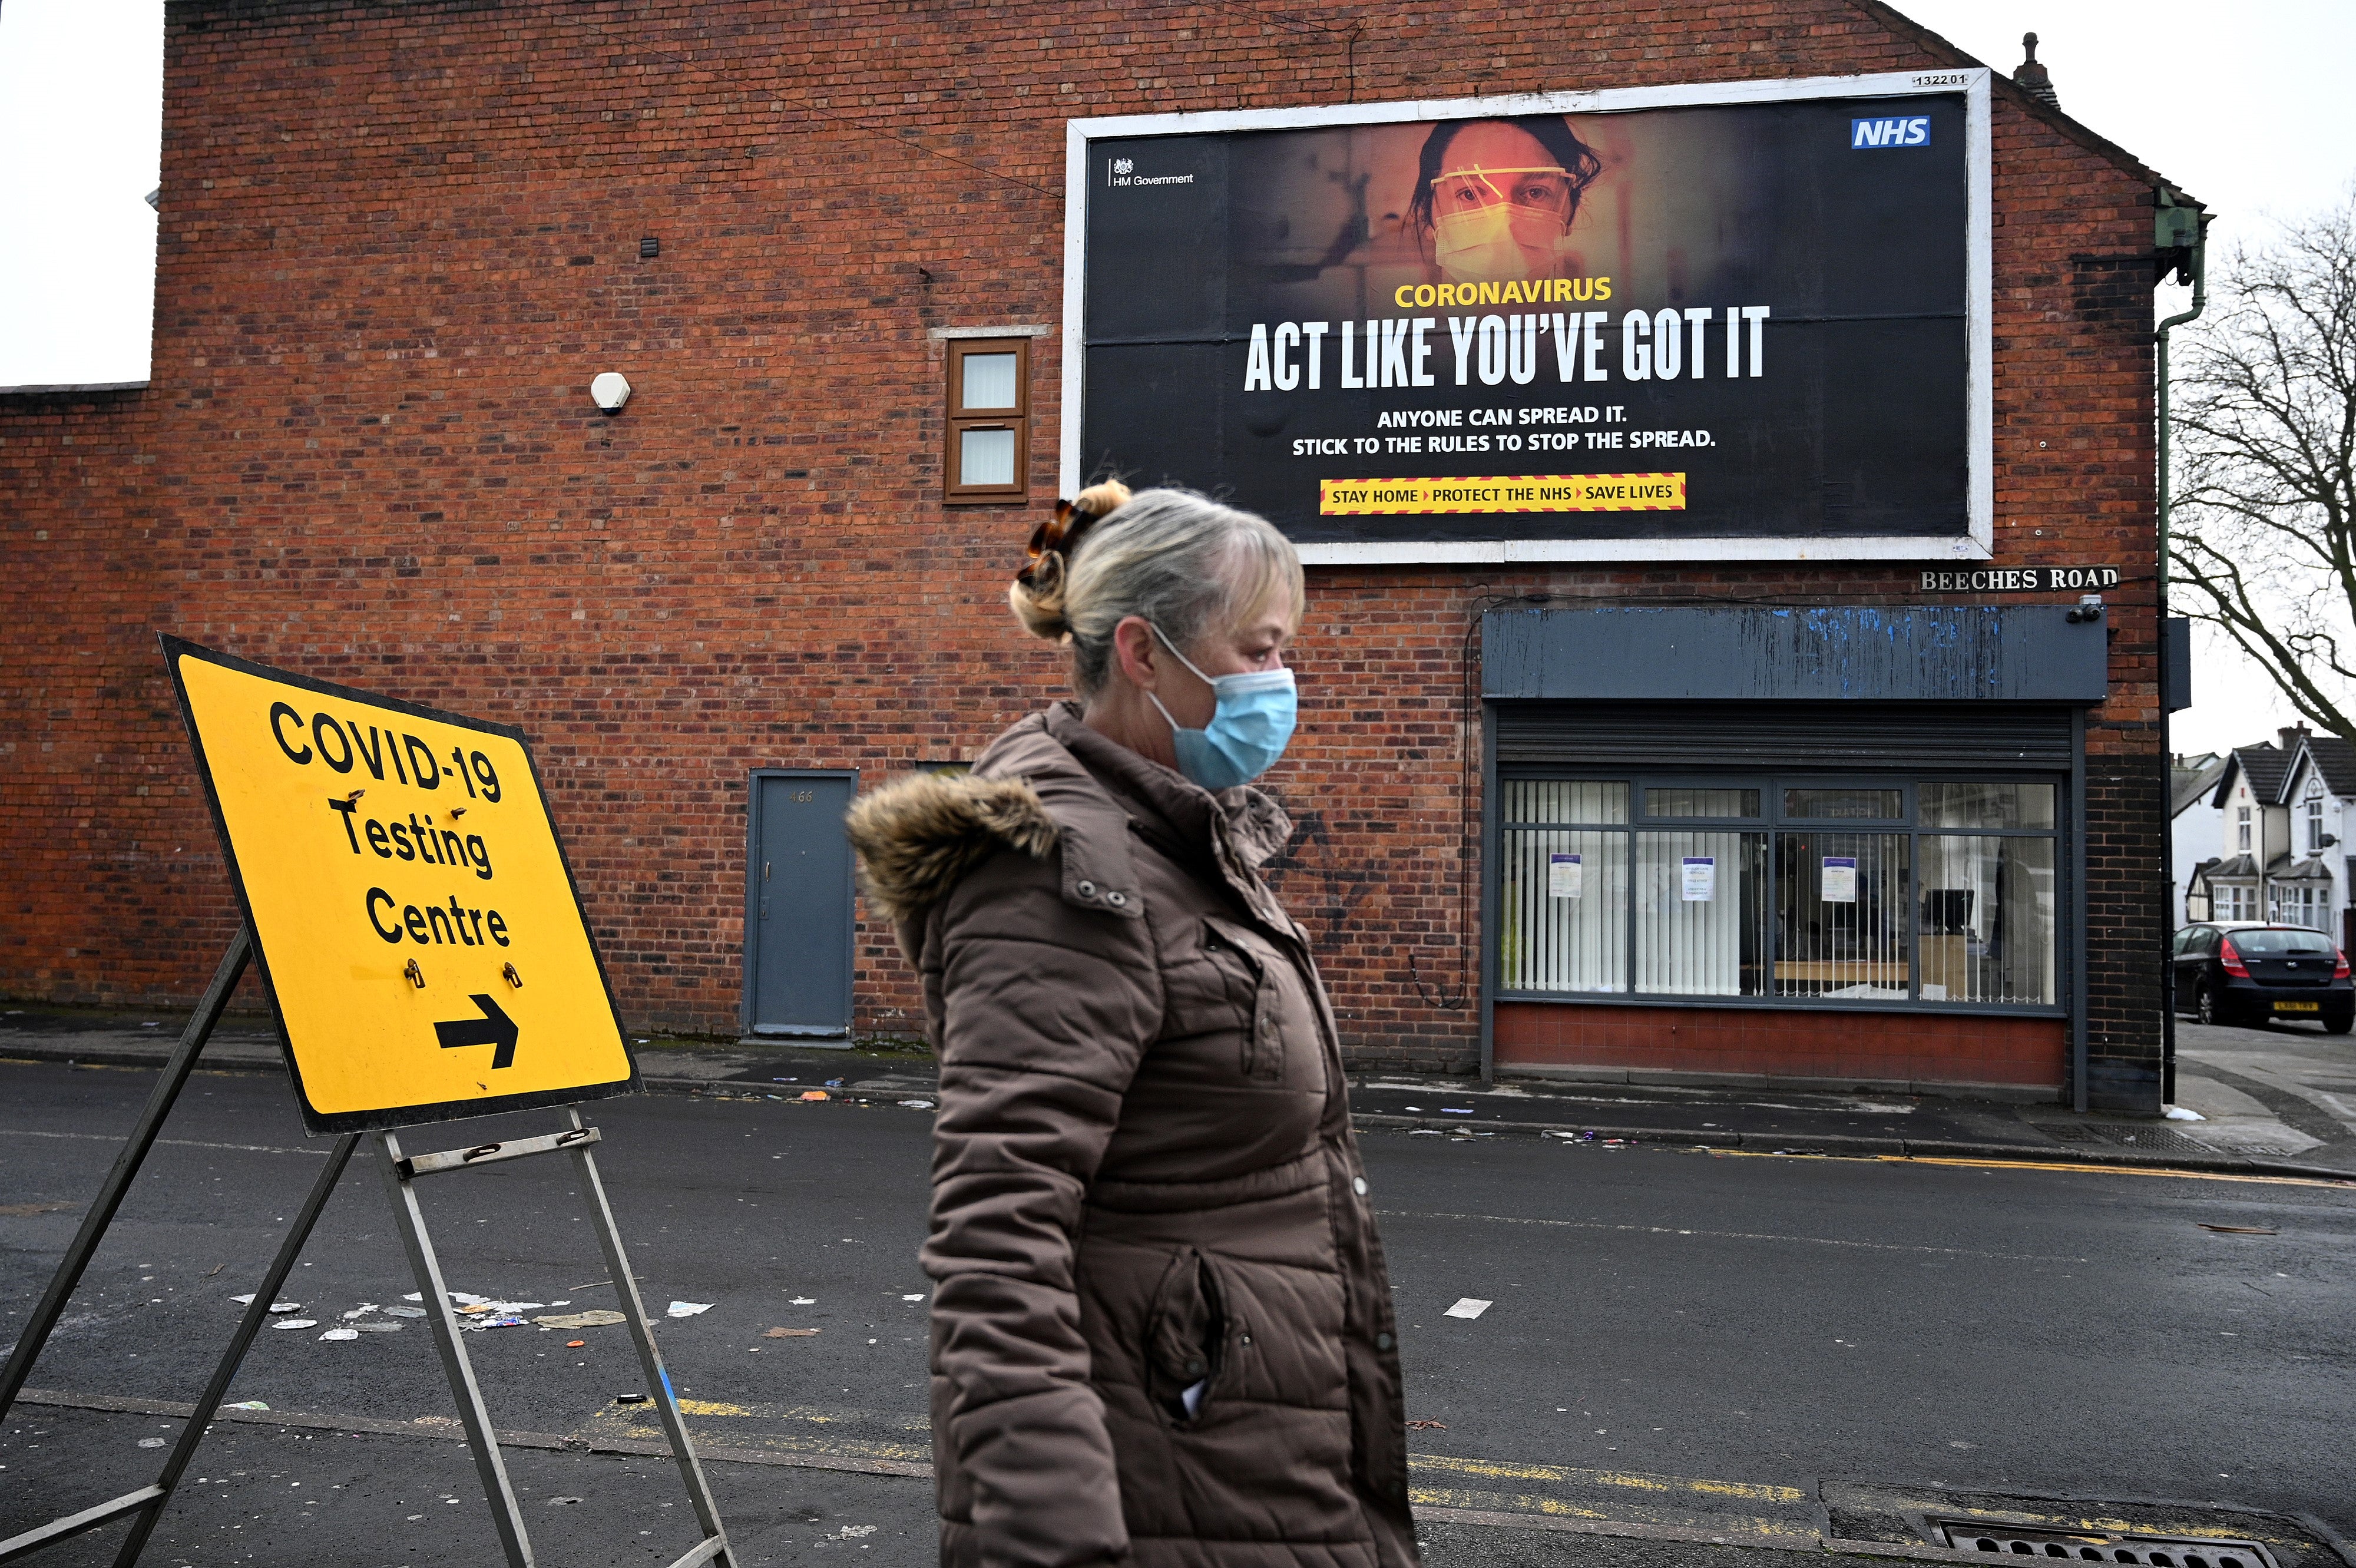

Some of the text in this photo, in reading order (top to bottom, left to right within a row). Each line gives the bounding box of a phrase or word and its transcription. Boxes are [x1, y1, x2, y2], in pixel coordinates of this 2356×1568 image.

[1917, 75, 1964, 85] 132201
[1855, 119, 1927, 145] NHS
[1113, 174, 1194, 187] HM Government
[1395, 277, 1612, 308] CORONAVIRUS
[1244, 306, 1770, 391] ACT LIKE YOU'VE GOT IT
[1376, 406, 1627, 428] ANYONE CAN SPREAD IT.
[1293, 431, 1716, 456] STICK TO THE RULES TO STOP THE SPREAD.
[1332, 485, 1672, 504] STAY HOME PROTECT THE NHS SAVE LIVES
[1921, 569, 2117, 590] BEECHES ROAD
[270, 702, 501, 803] COVID-19
[789, 791, 812, 802] 466
[328, 799, 492, 880] Testing
[366, 887, 510, 947] Centre
